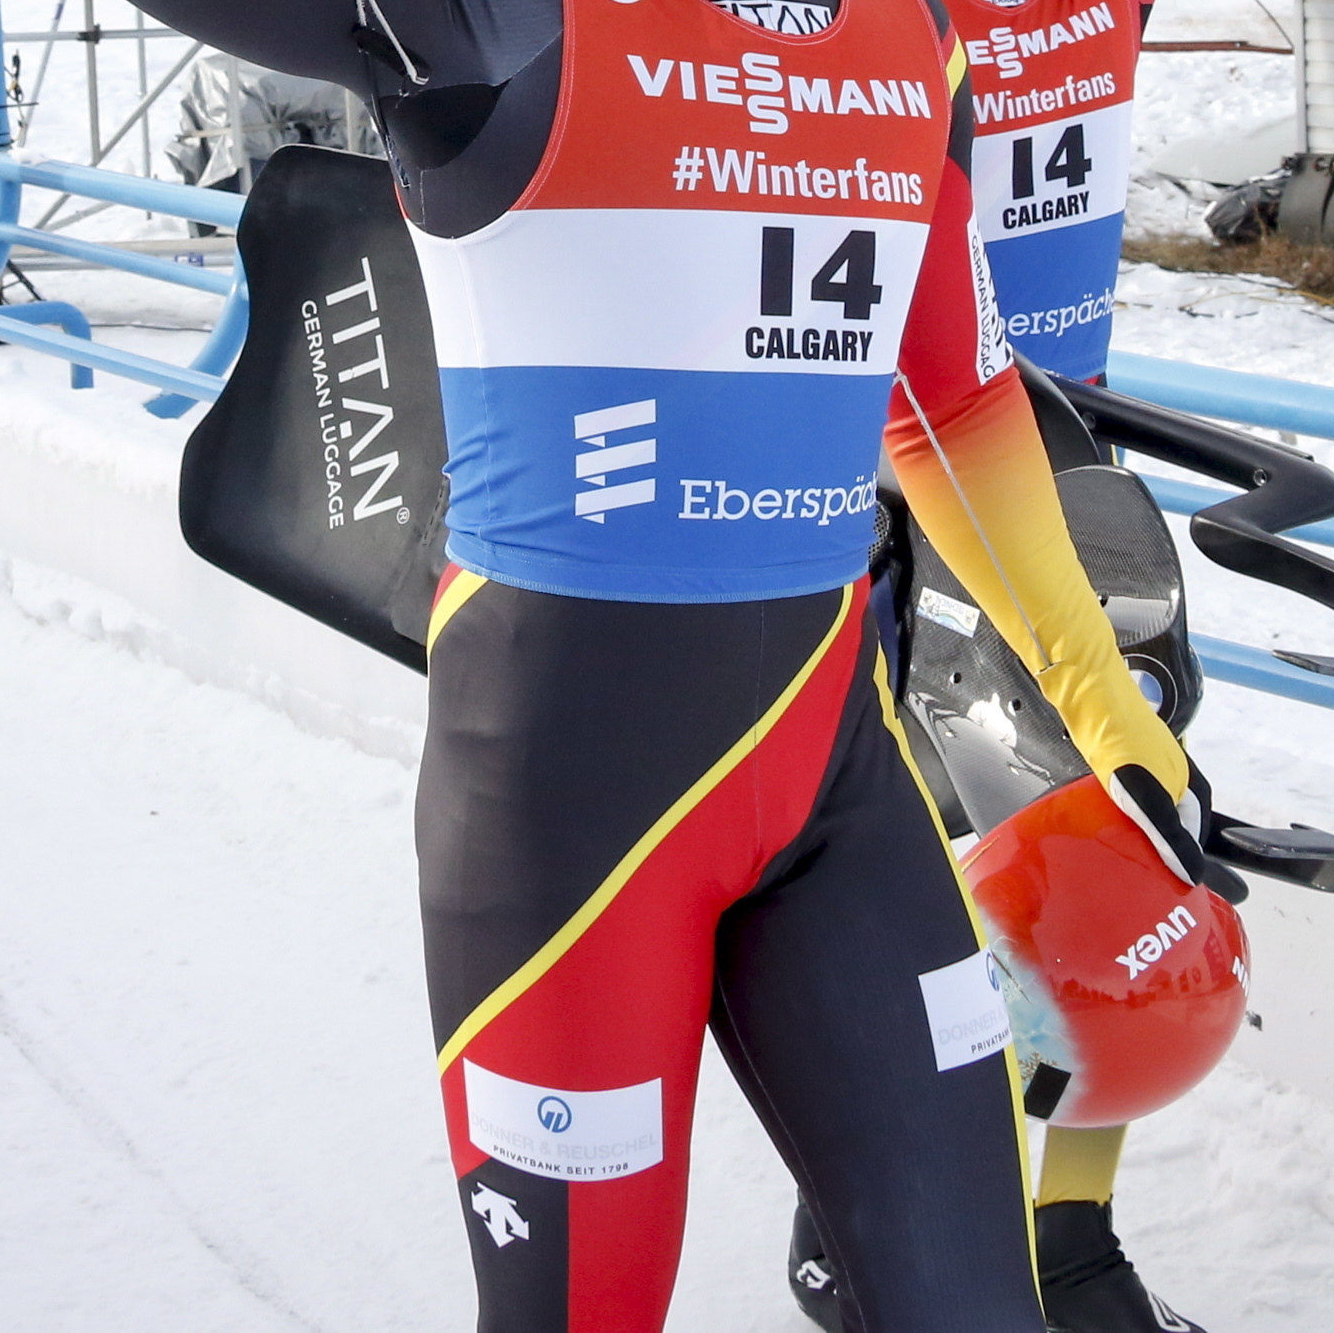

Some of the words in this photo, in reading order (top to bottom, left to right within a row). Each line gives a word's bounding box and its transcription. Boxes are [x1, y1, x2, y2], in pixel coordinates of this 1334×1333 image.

[627, 52, 931, 134] VIESSMANN
[973, 72, 1116, 125] Winterfans
[672, 146, 923, 205] #Winterfans
[1012, 123, 1092, 200] 14
[1003, 190, 1089, 229] CALGARY
[760, 226, 883, 320] 14
[745, 326, 873, 362] CALGARY
[981, 314, 996, 378] LUGGAG
[301, 299, 333, 408] GERMAN
[319, 412, 344, 529] LUGGAGE
[325, 256, 404, 521] TITAN
[1115, 904, 1197, 980] uvex
[471, 1113, 534, 1153] DONNER
[539, 1140, 552, 1156] &
[557, 1133, 659, 1161] REUSCHEL
[493, 1145, 561, 1173] PRIVATBANK
[567, 1166, 596, 1175] SEIT
[602, 1162, 629, 1174] 1798
